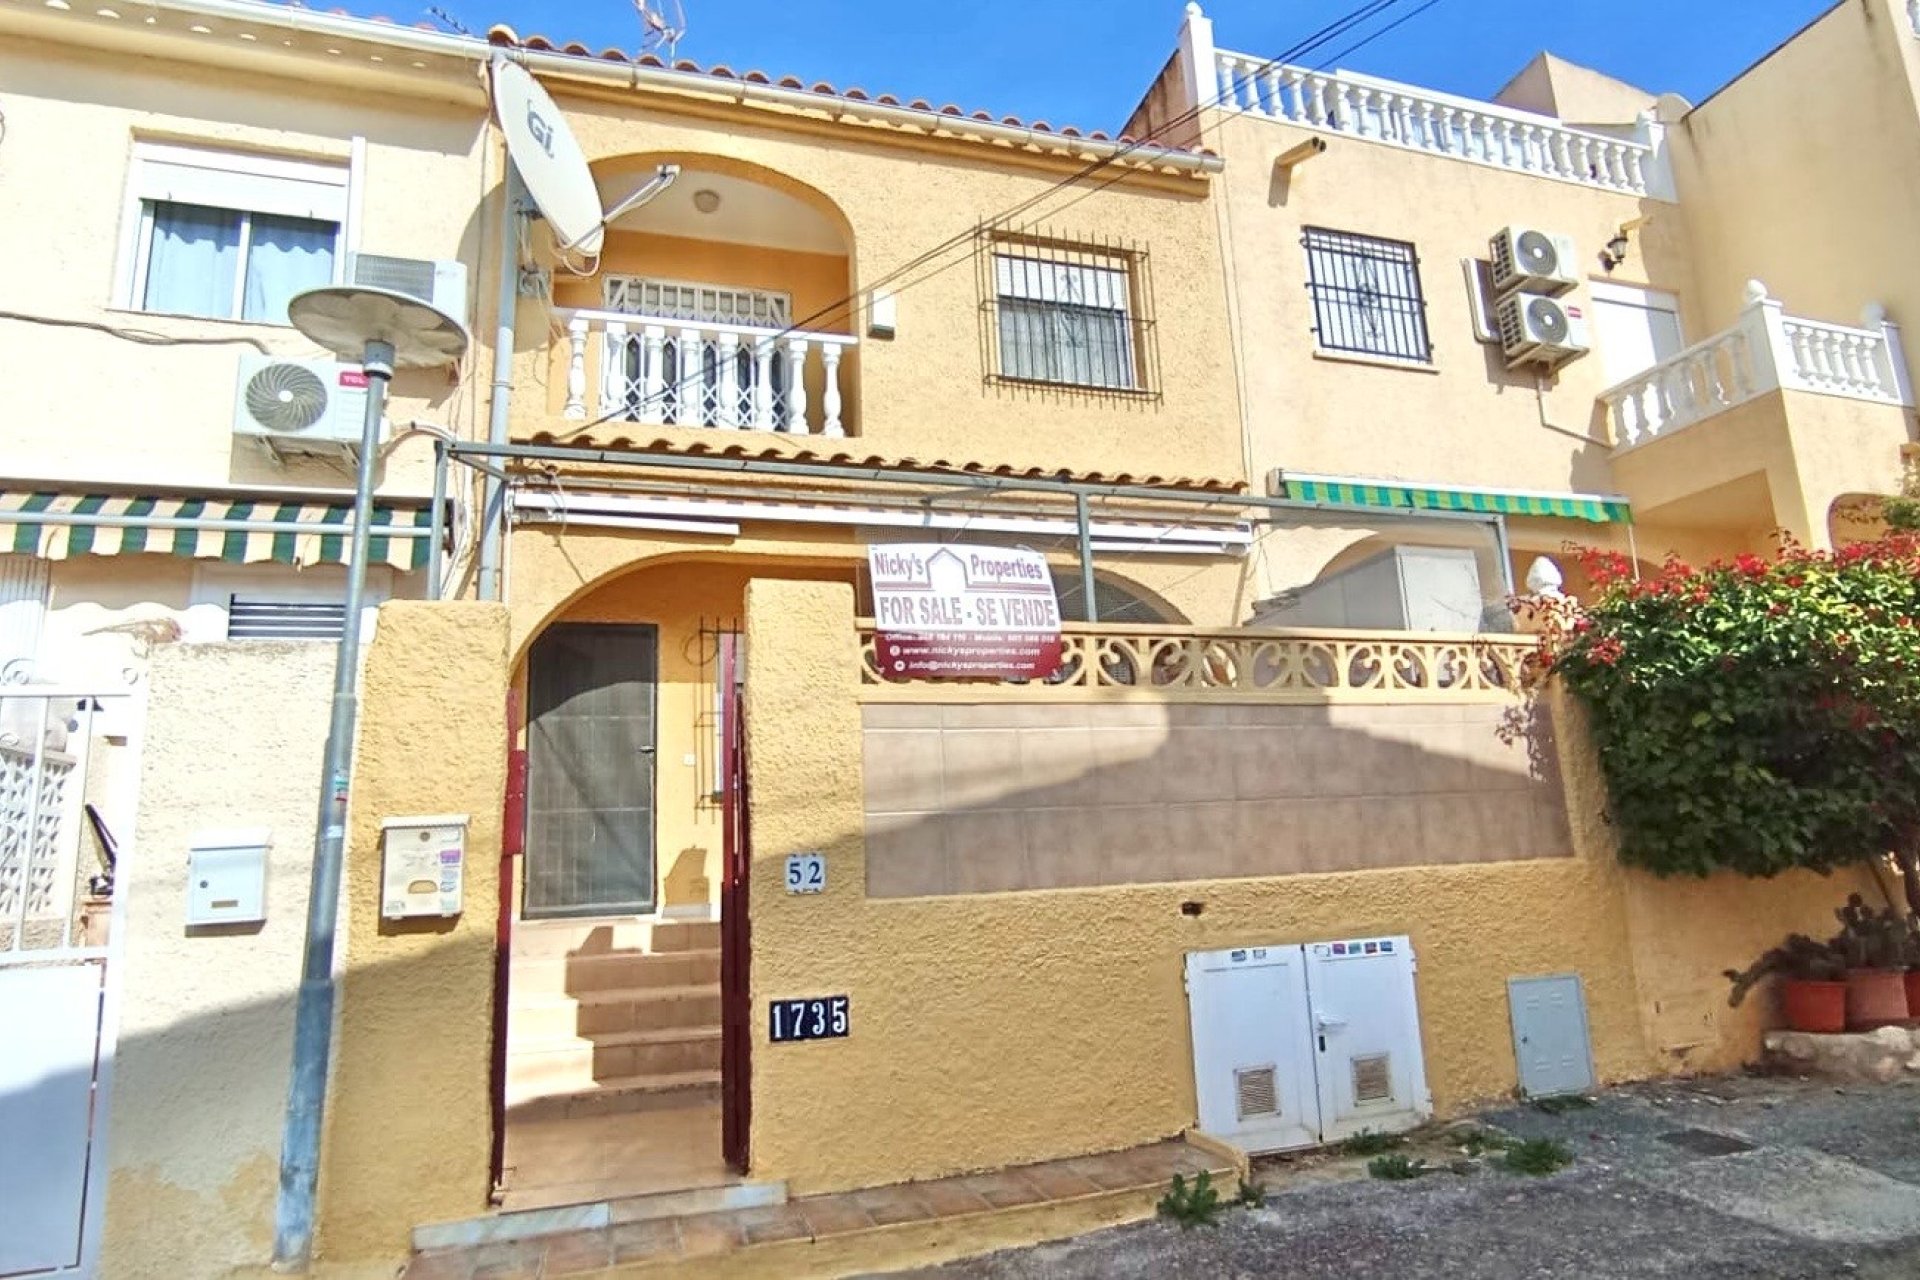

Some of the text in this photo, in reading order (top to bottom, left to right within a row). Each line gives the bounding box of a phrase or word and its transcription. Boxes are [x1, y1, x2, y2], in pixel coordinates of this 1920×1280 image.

[874, 553, 1043, 584] Nicky's Properties
[879, 597, 915, 625] FOR
[920, 597, 963, 626] SALE
[977, 598, 997, 626] SE
[1002, 599, 1056, 627] VENDE
[902, 646, 1040, 657] www.nickysproperties.com
[788, 861, 822, 885] 52
[772, 999, 847, 1038] 1735
